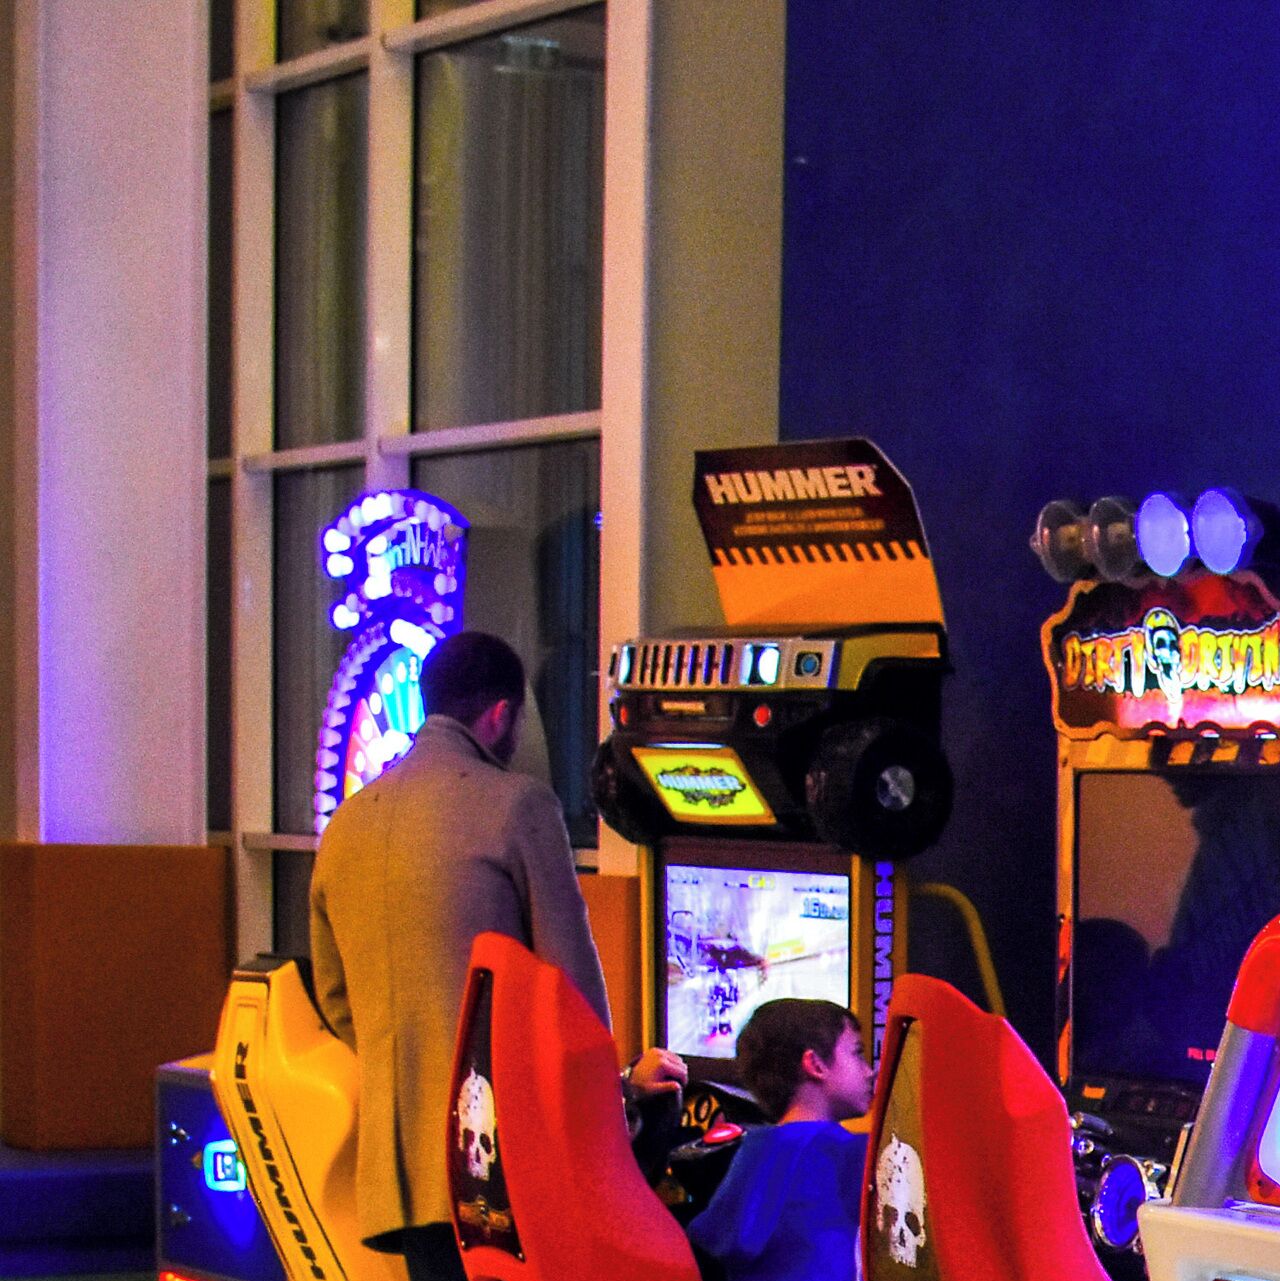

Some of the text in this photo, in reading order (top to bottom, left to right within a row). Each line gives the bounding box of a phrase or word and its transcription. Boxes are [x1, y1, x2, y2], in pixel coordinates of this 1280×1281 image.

[704, 463, 884, 506] HUMMER
[1062, 626, 1146, 698] DIRTY
[873, 861, 894, 1075] HUMME
[234, 1040, 328, 1281] HUMMER
